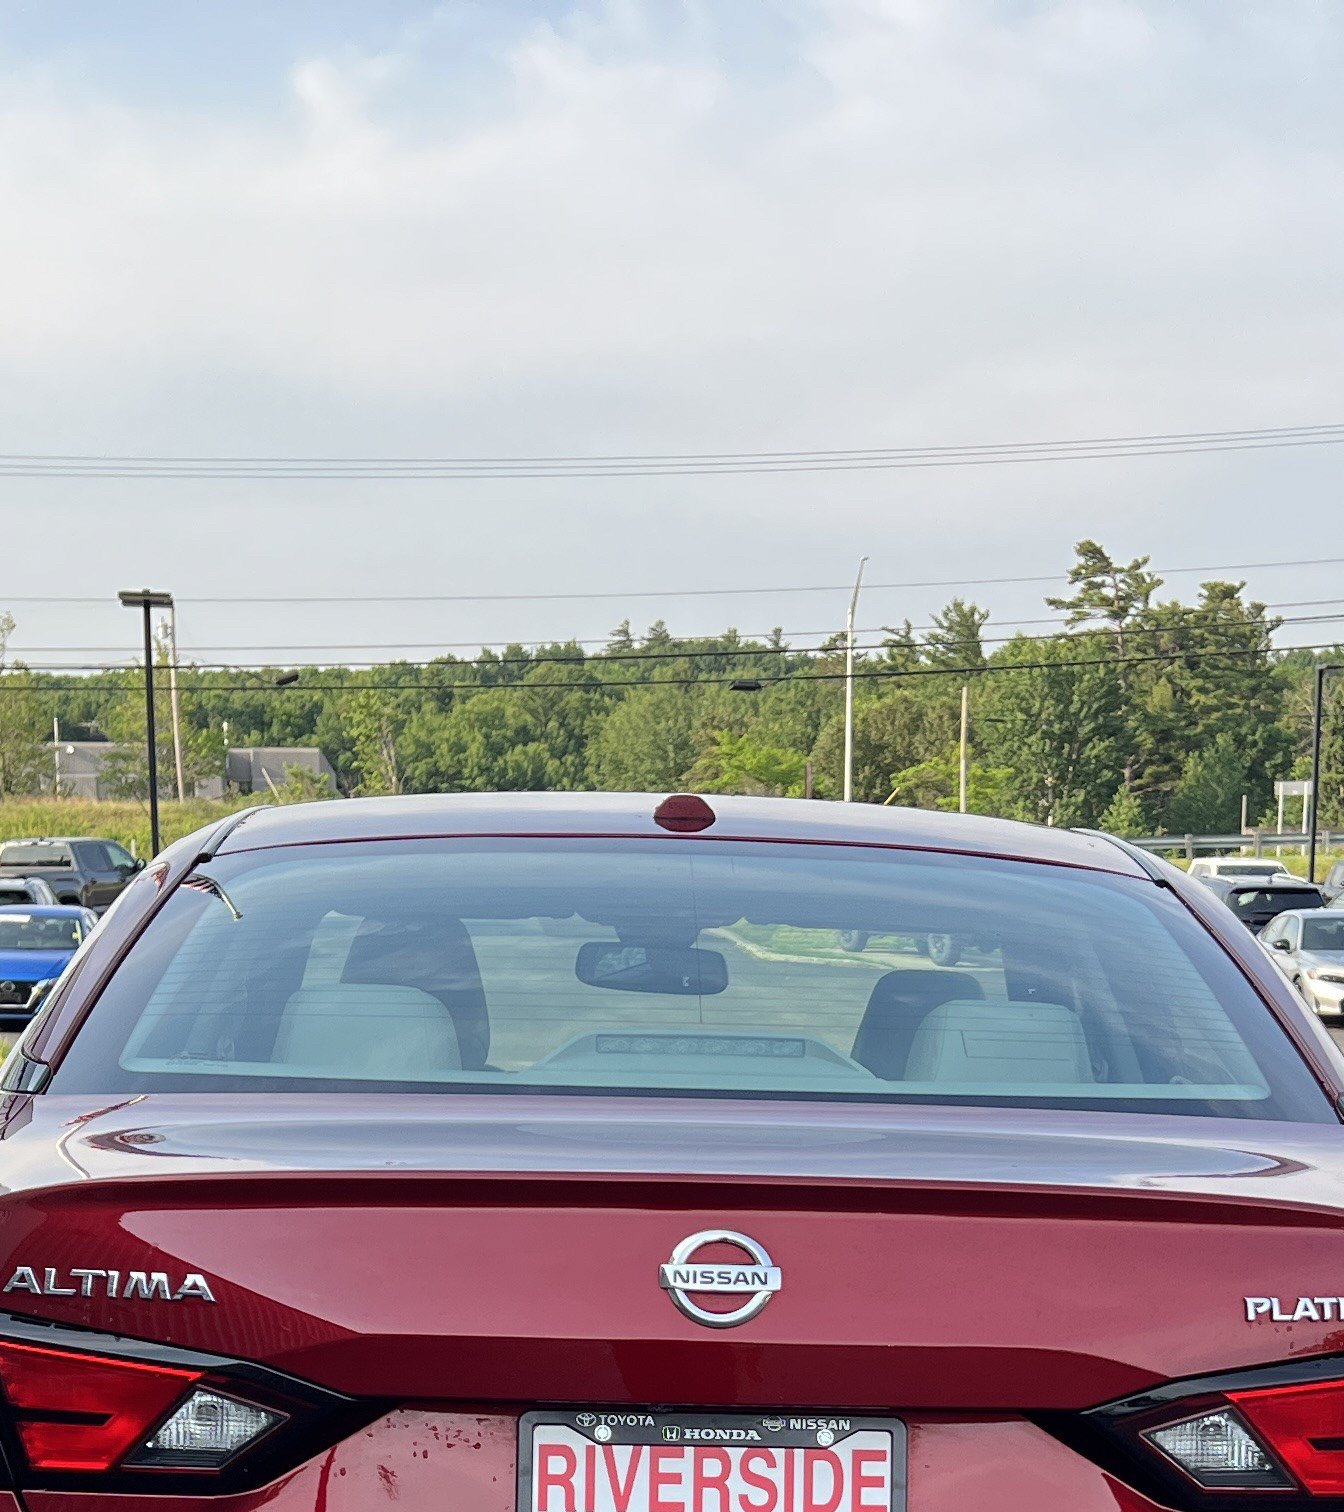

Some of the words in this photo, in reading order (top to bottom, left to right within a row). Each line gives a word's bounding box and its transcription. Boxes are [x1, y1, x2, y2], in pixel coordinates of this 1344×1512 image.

[3, 1266, 216, 1302] ALTIMA
[673, 1270, 768, 1286] NISSAN
[599, 1414, 655, 1427] TOYOTA
[789, 1417, 851, 1432] NISSAN
[683, 1428, 761, 1441] HONDA
